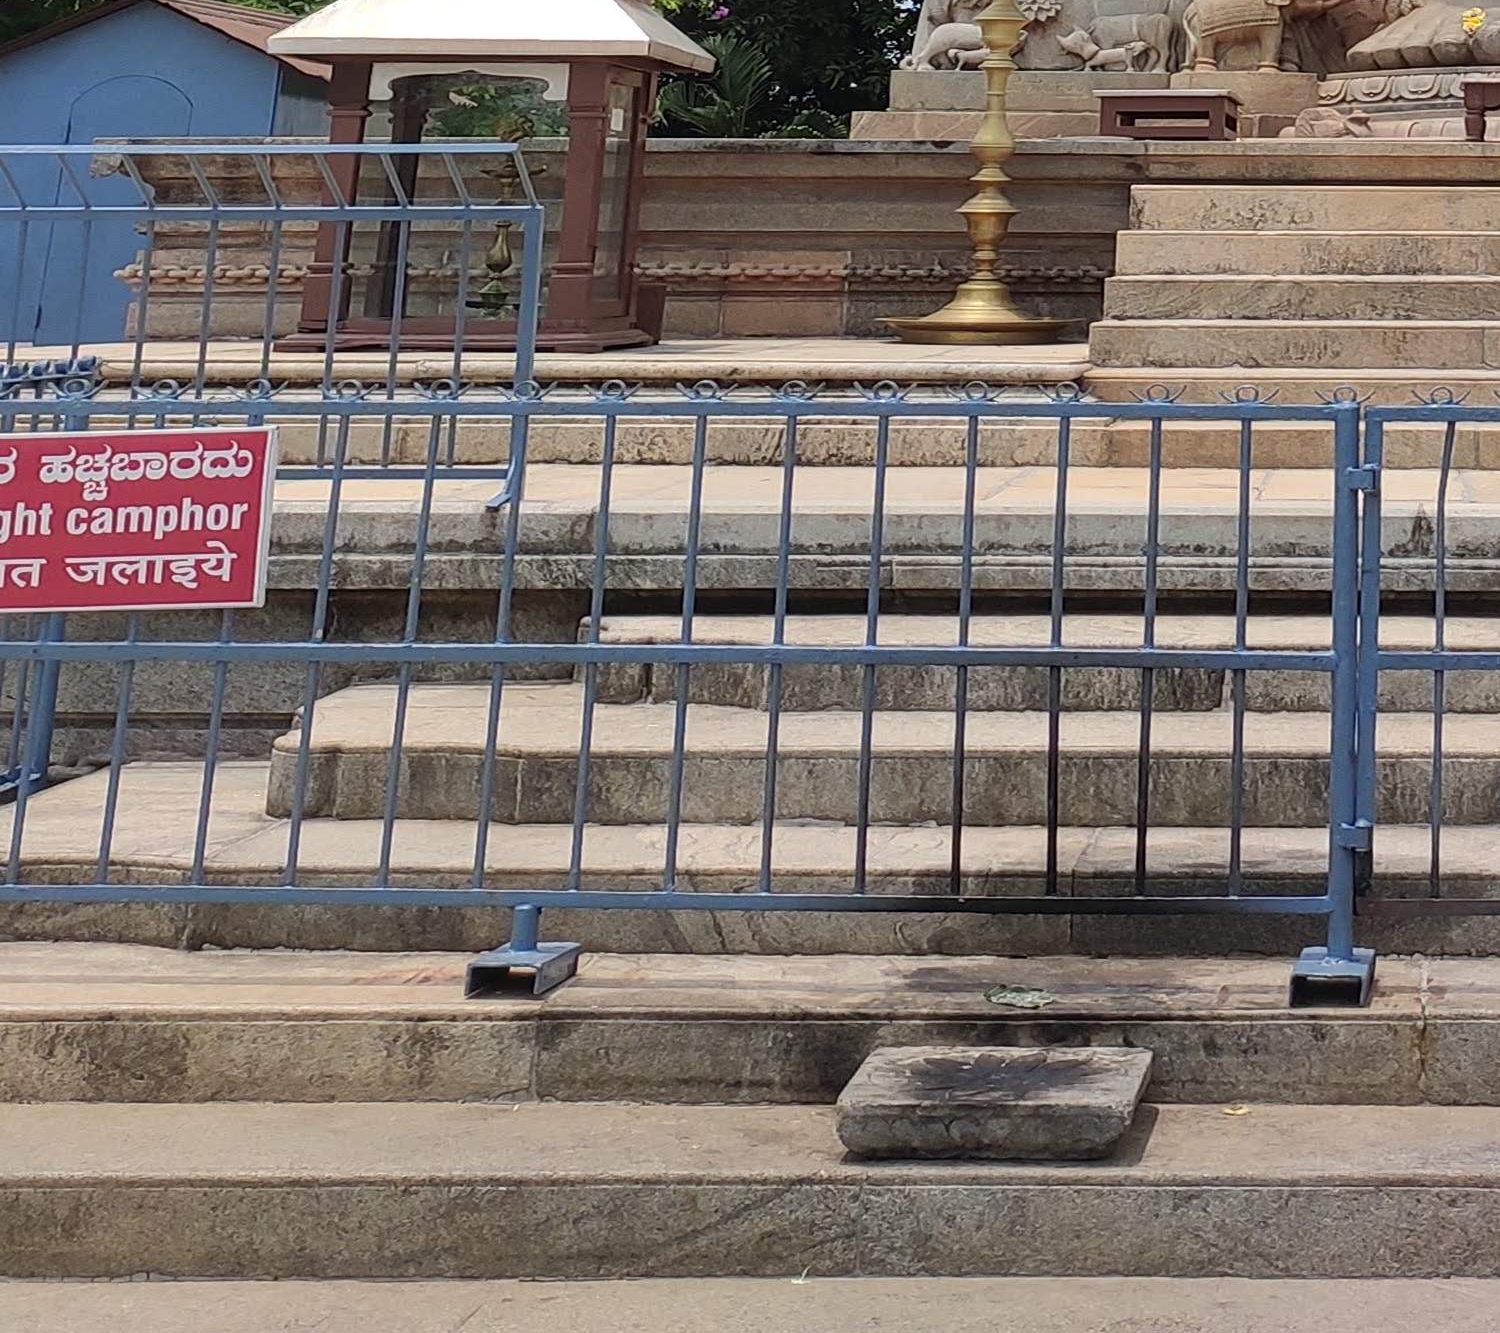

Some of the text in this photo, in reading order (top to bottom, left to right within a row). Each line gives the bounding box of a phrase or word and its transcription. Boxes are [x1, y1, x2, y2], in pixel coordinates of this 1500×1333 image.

[39, 440, 253, 501] ಹಚ್ಚಬಾರದು
[66, 497, 248, 540] camphor
[0, 540, 238, 589] त जलाइये
